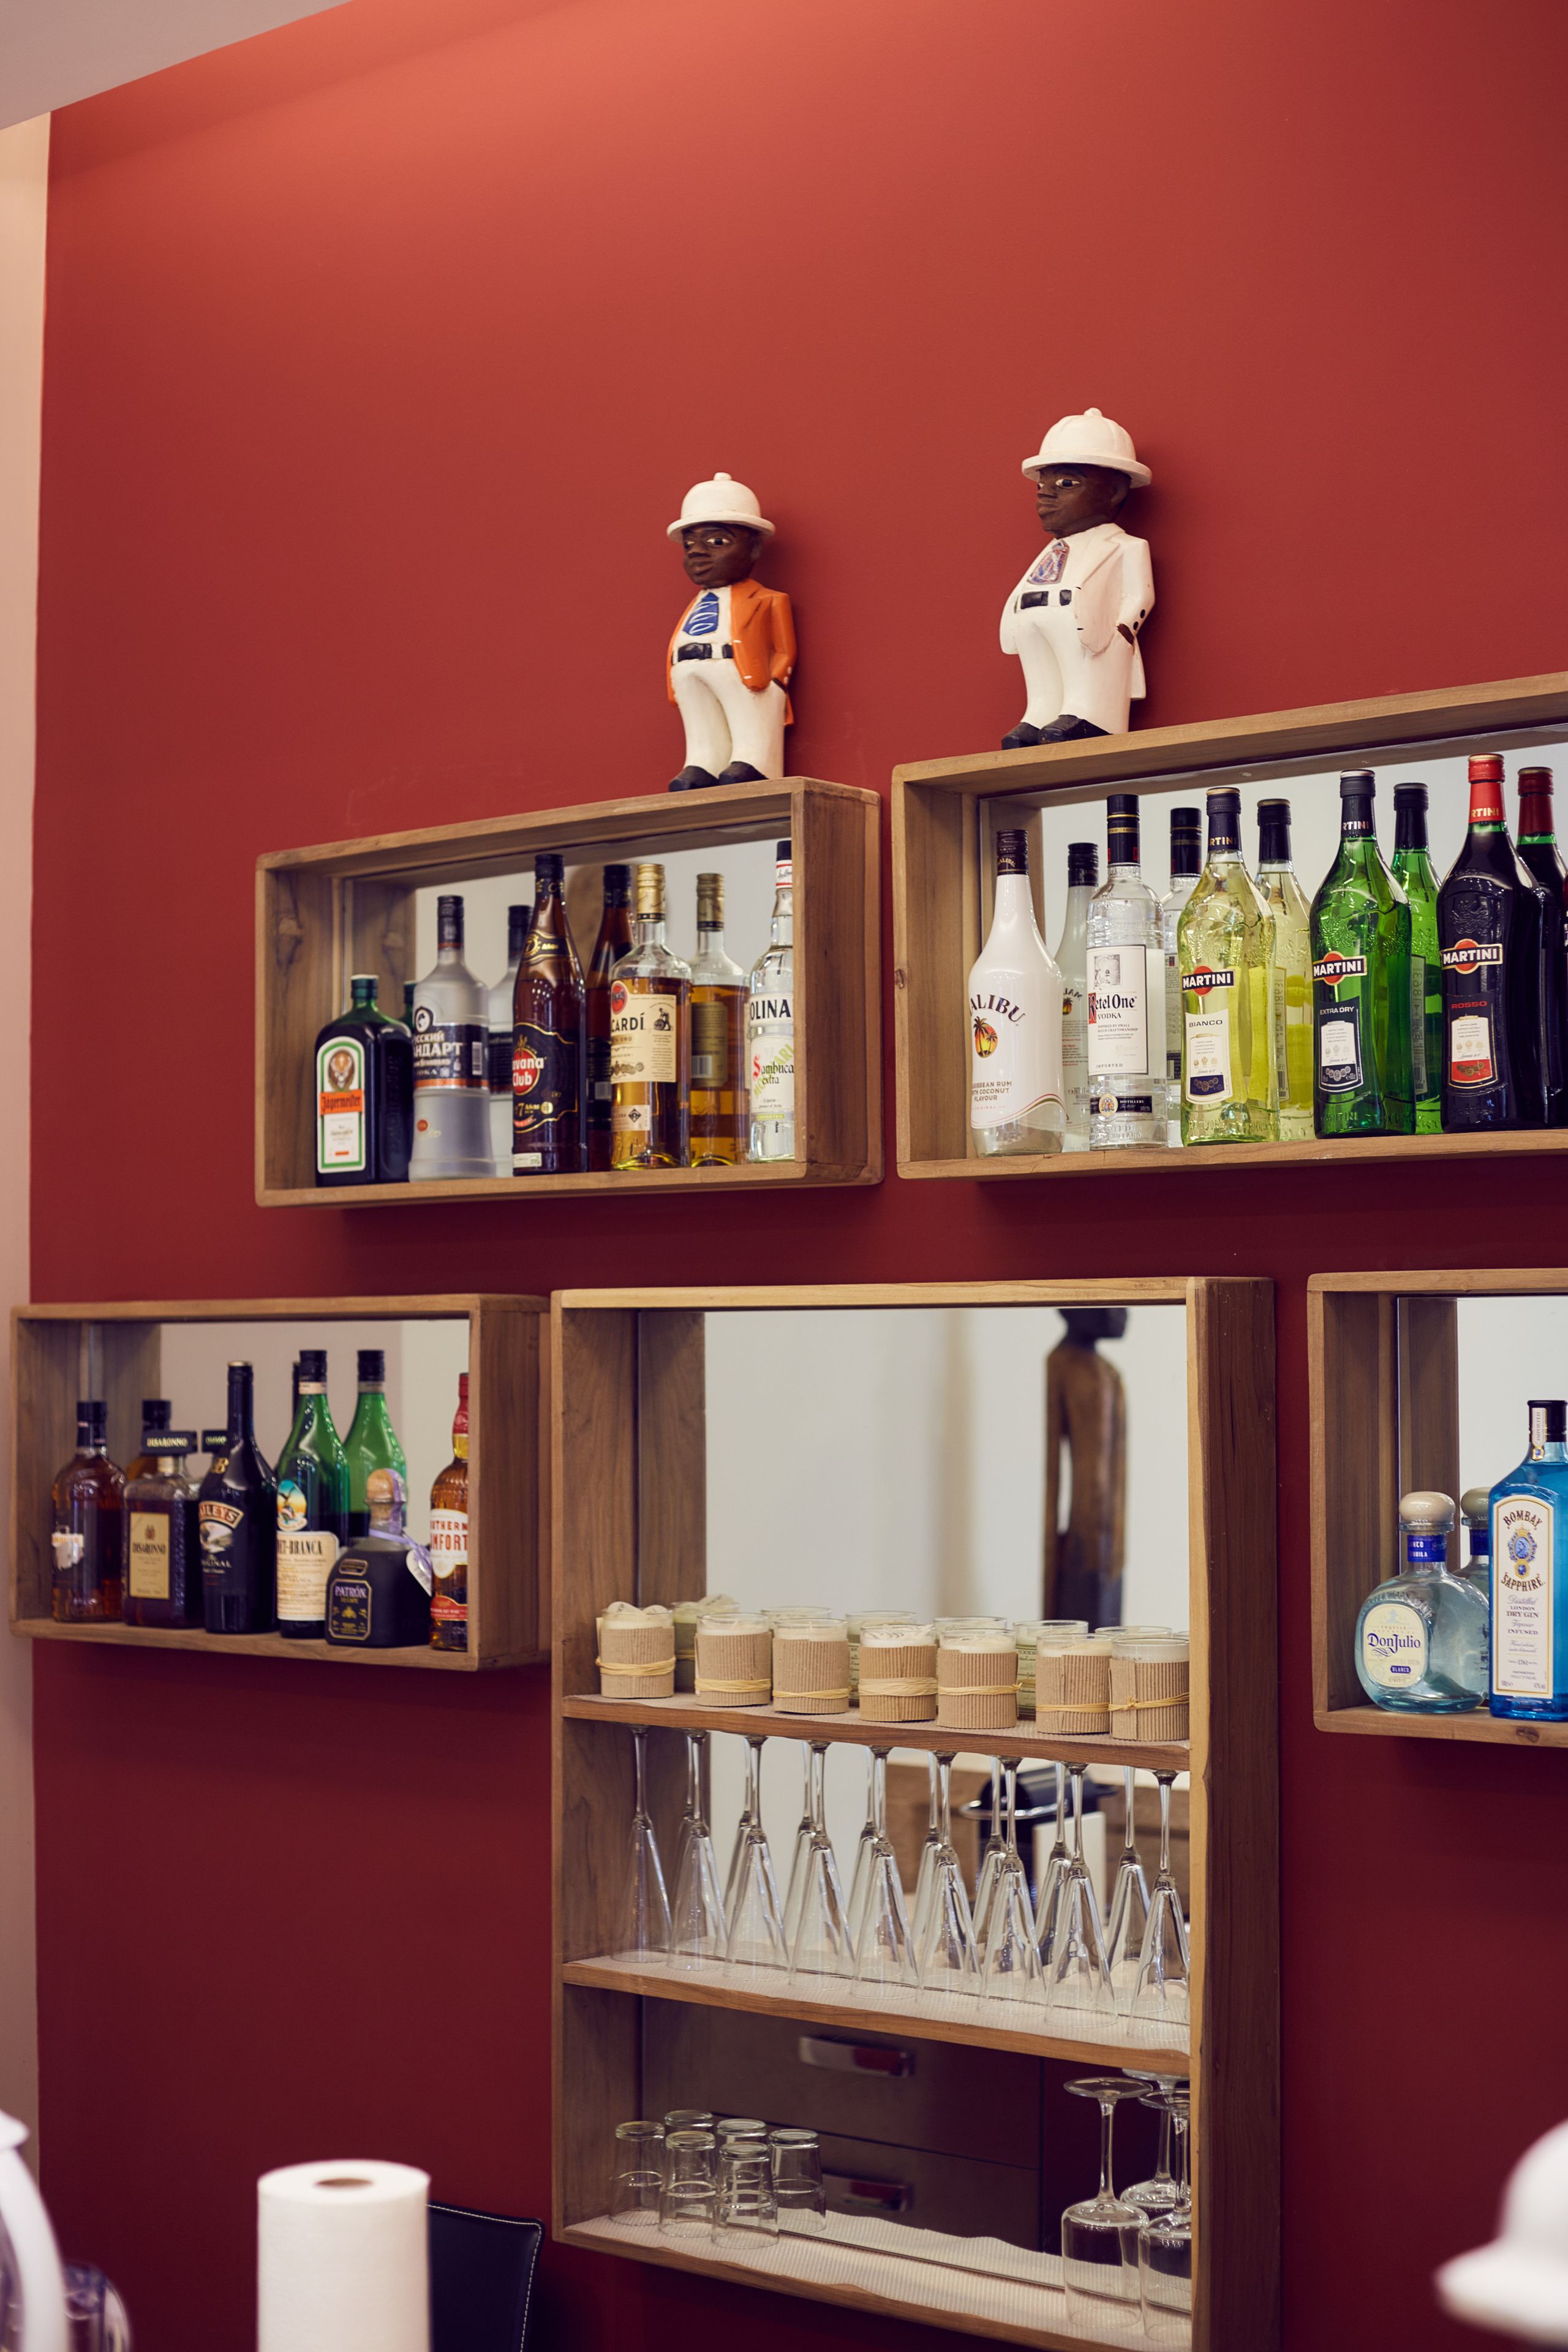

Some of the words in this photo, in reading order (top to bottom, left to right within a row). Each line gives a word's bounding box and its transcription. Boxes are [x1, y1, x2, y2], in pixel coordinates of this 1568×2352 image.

[1443, 948, 1498, 965] MARTINI
[1313, 960, 1362, 977] MARTINI
[1183, 973, 1231, 989] MARTINI
[1088, 993, 1110, 1023] Ketel
[1112, 993, 1136, 1009] One
[1451, 1000, 1488, 1009] ROSSO
[1189, 1019, 1223, 1028] BIANCO
[753, 1055, 794, 1077] Sambuca
[762, 1074, 779, 1085] extra
[147, 1436, 189, 1447] DISARONNO
[1503, 1510, 1543, 1529] BOMBAY
[1501, 1572, 1544, 1592] SAPPHIRE
[334, 1585, 368, 1599] PATRÓN
